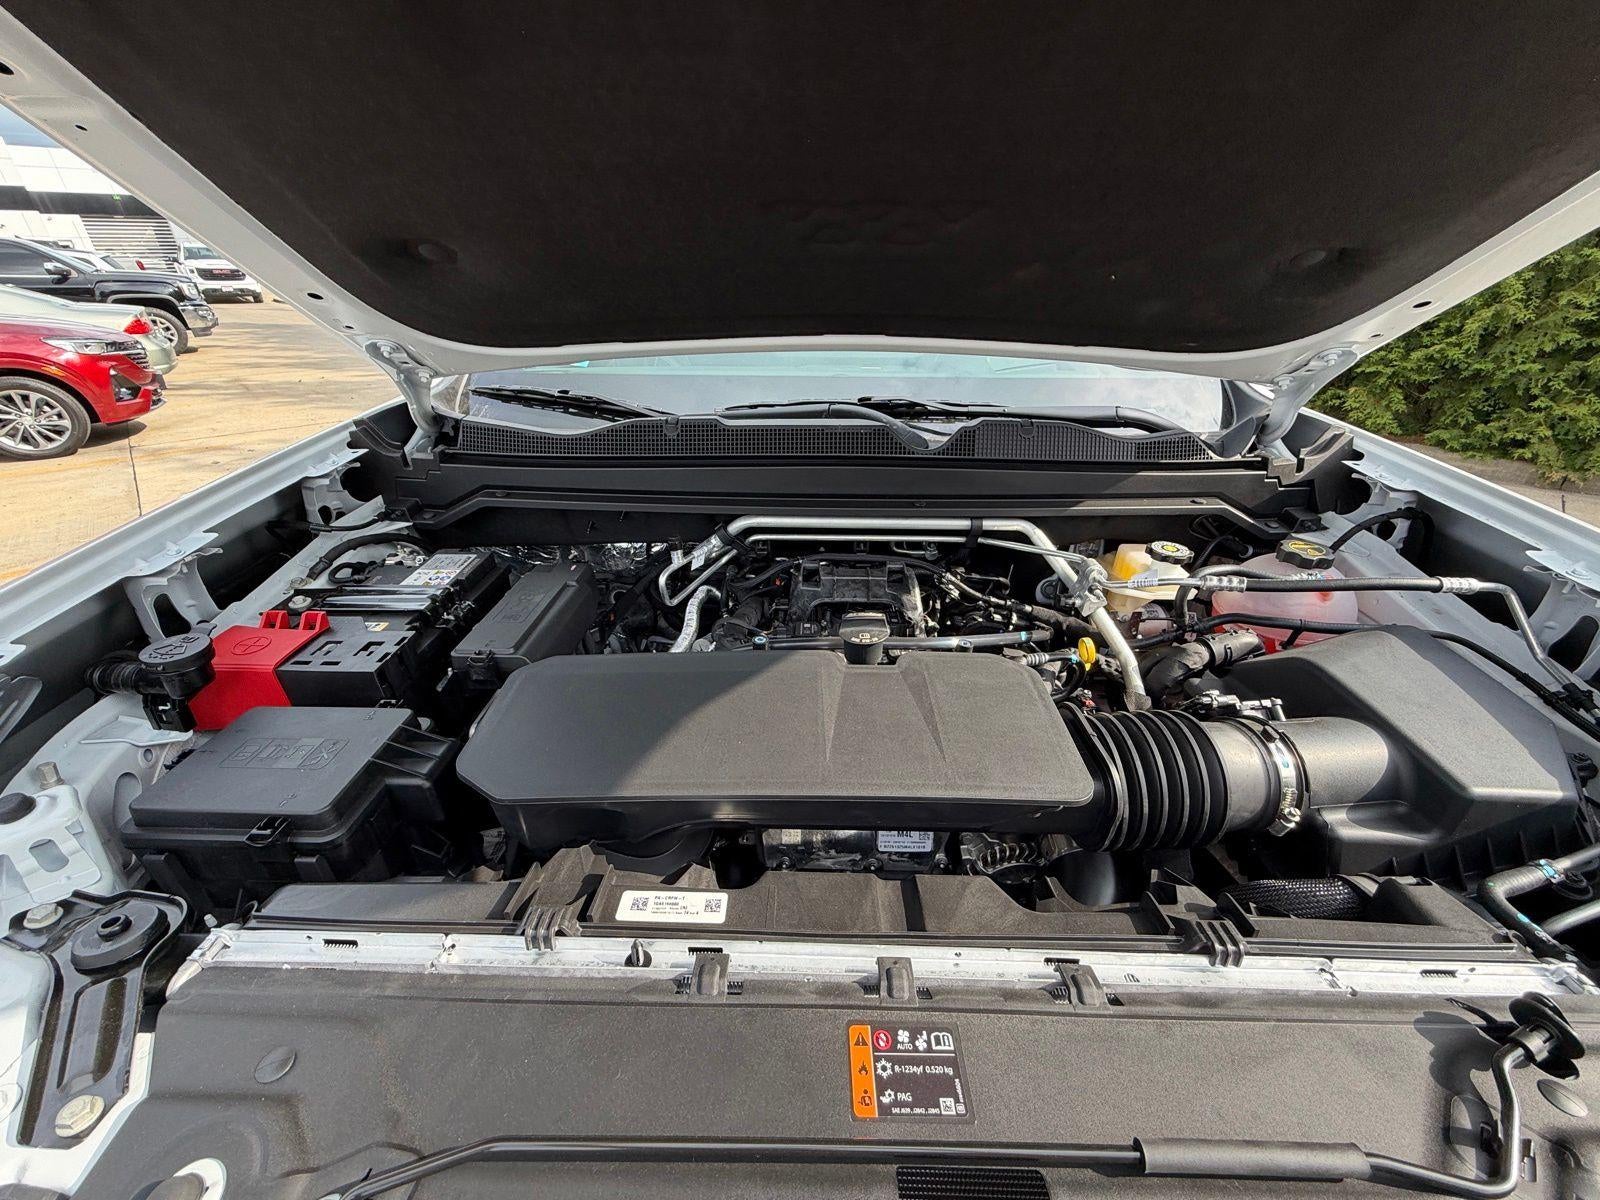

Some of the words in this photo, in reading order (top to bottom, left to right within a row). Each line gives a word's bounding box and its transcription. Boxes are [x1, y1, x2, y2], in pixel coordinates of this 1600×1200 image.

[894, 1065, 923, 1075] R-1234yf
[925, 1065, 944, 1074] 0.520
[944, 1065, 954, 1075] kg
[897, 1093, 912, 1101] PAG
